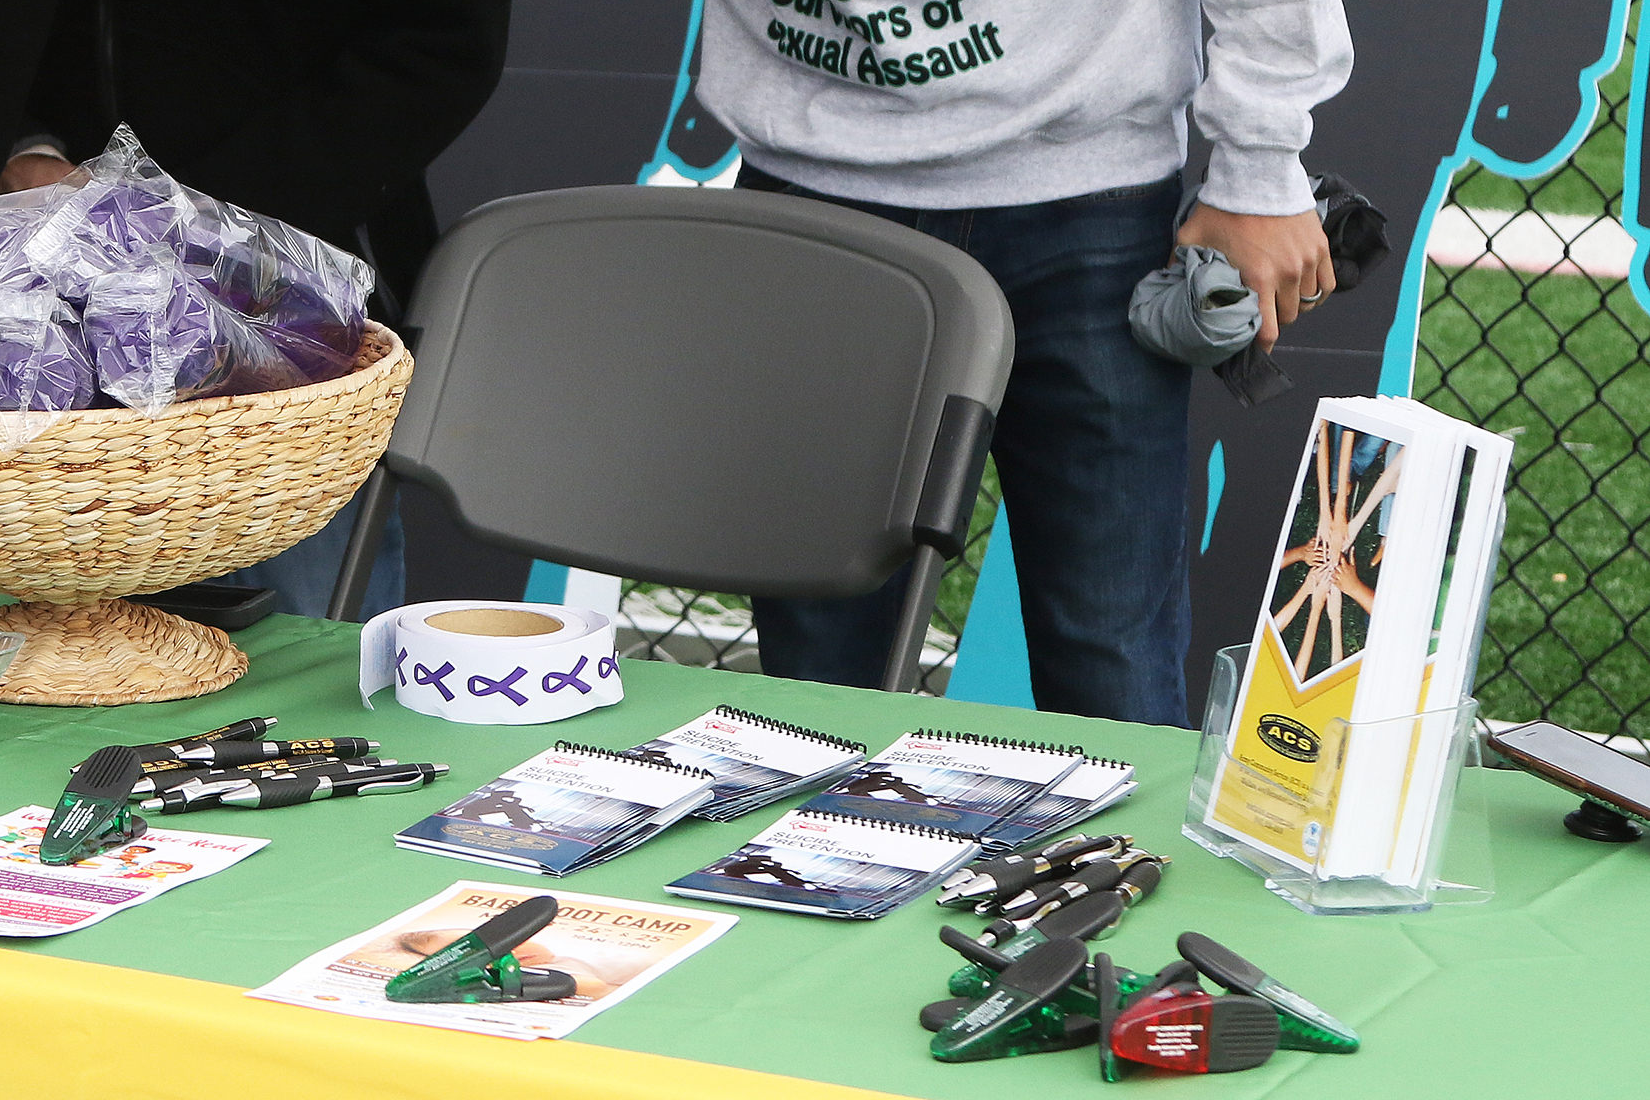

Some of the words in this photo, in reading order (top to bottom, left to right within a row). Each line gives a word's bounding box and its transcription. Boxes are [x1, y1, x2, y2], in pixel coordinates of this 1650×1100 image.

[857, 21, 1004, 87] Assault
[672, 734, 764, 761] PREVENTION
[683, 729, 742, 748] SUICIDE
[1268, 725, 1312, 751] ACS
[884, 756, 991, 771] PREVENTION
[890, 751, 958, 761] SUICIDE
[515, 771, 616, 794] PREVENTION
[525, 765, 590, 781] SUICIDE
[765, 837, 876, 859] PREVENTION
[773, 831, 843, 847] SUICIDE
[463, 894, 519, 910] BAB
[556, 905, 611, 921] OOT
[612, 914, 693, 934] CAMP
